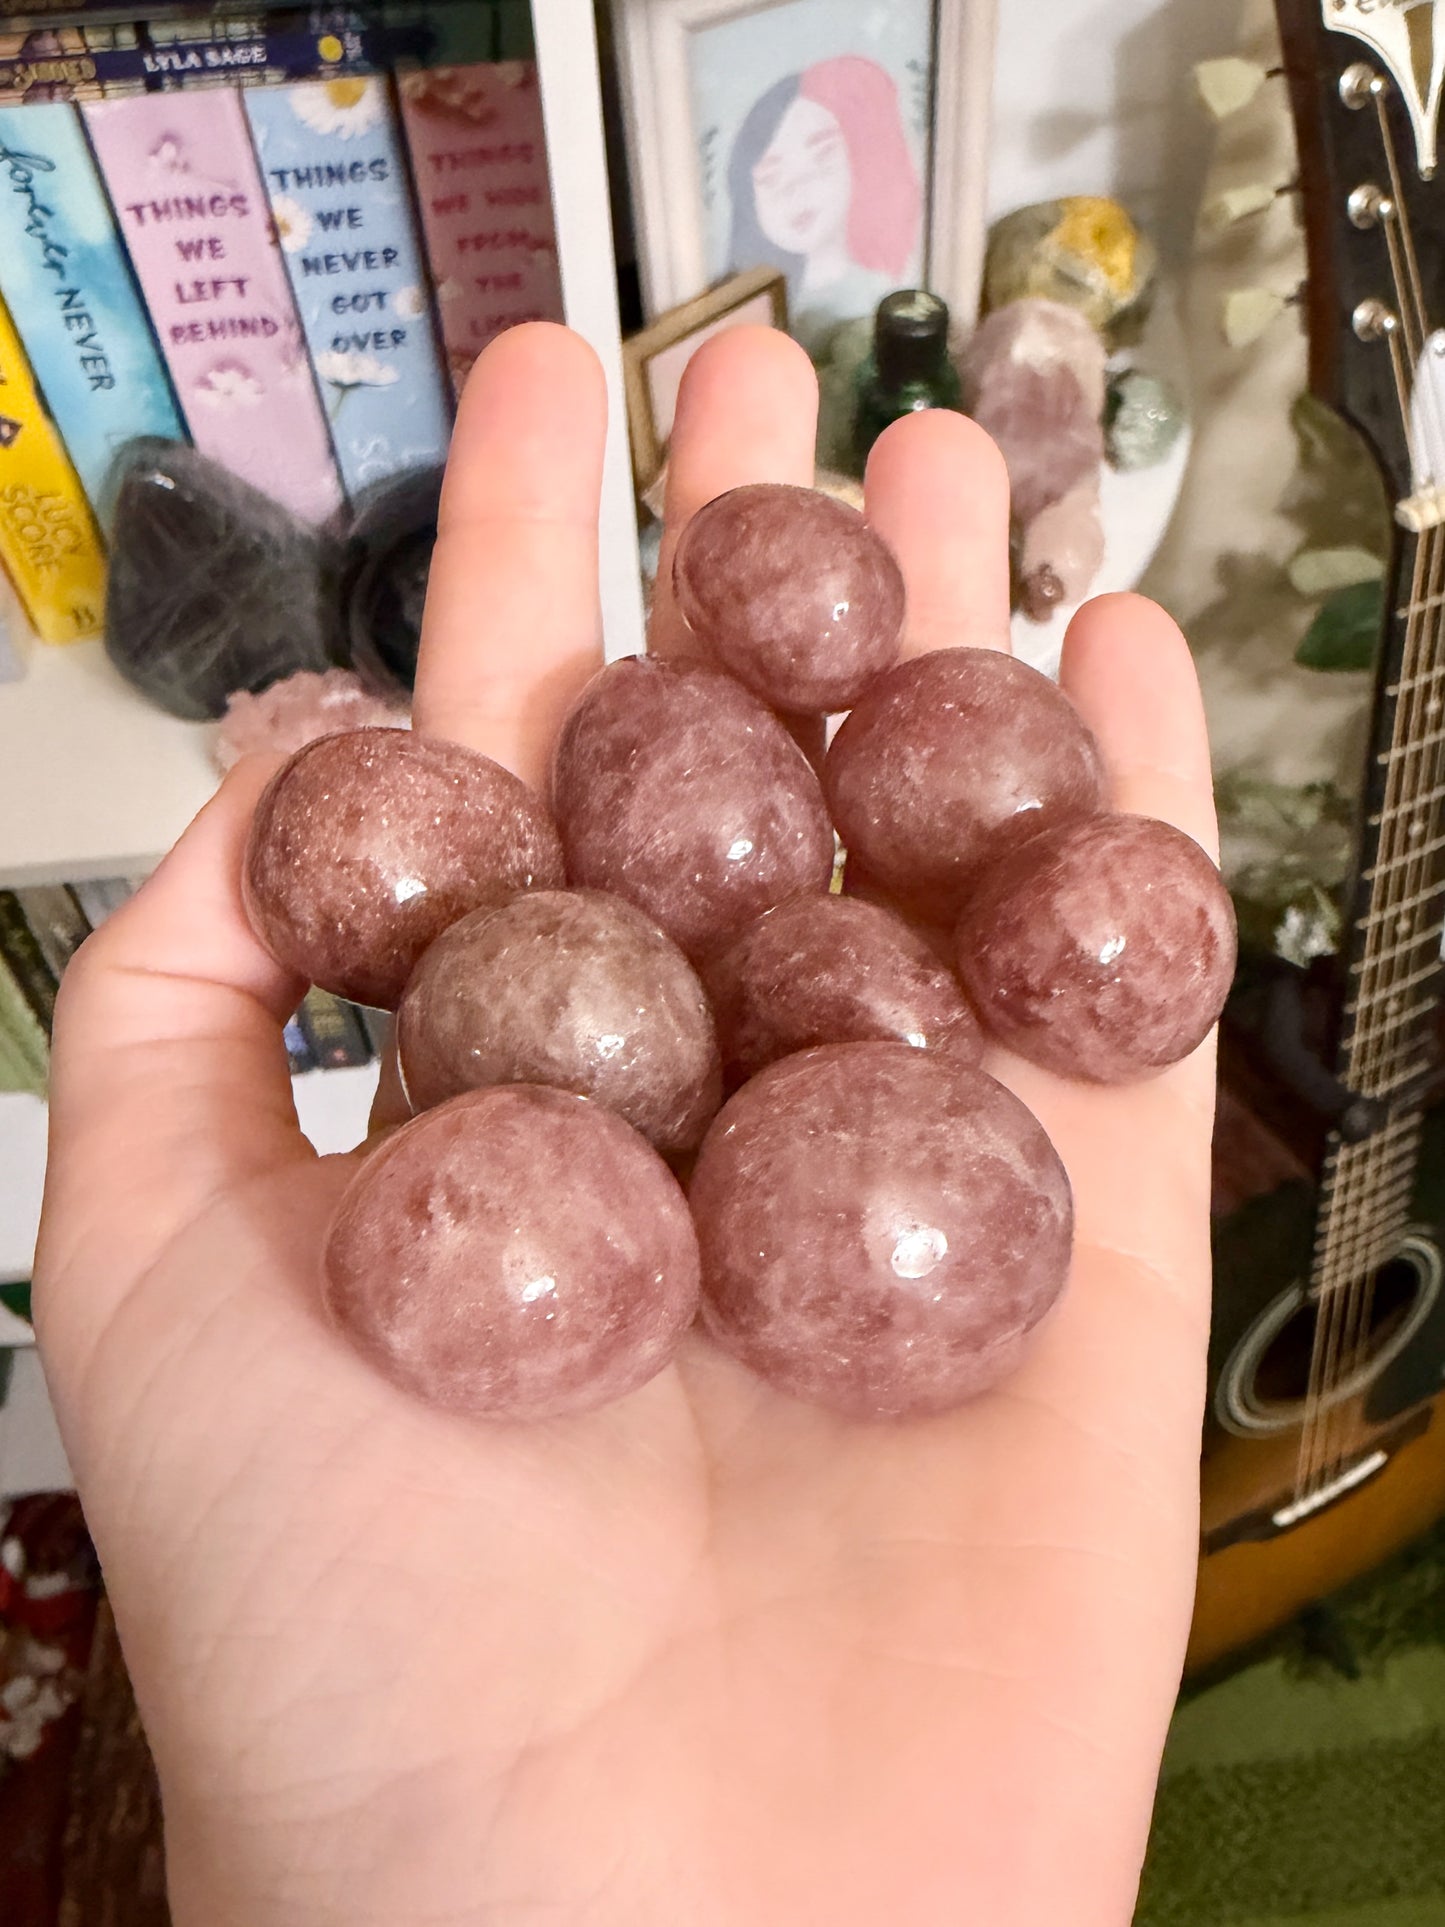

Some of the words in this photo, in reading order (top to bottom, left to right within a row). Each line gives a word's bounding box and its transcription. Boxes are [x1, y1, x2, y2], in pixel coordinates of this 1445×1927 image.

[143, 49, 202, 73] LYLA
[270, 158, 390, 191] THINGS
[125, 195, 250, 226] THINGS
[315, 208, 363, 231] WE
[175, 237, 226, 262] WE
[302, 248, 399, 276] NEVER
[175, 278, 250, 304] LEFT
[331, 291, 390, 315] GOT
[54, 287, 116, 392] NEVER
[169, 317, 279, 345] BEHIND
[331, 329, 406, 354] OVER
